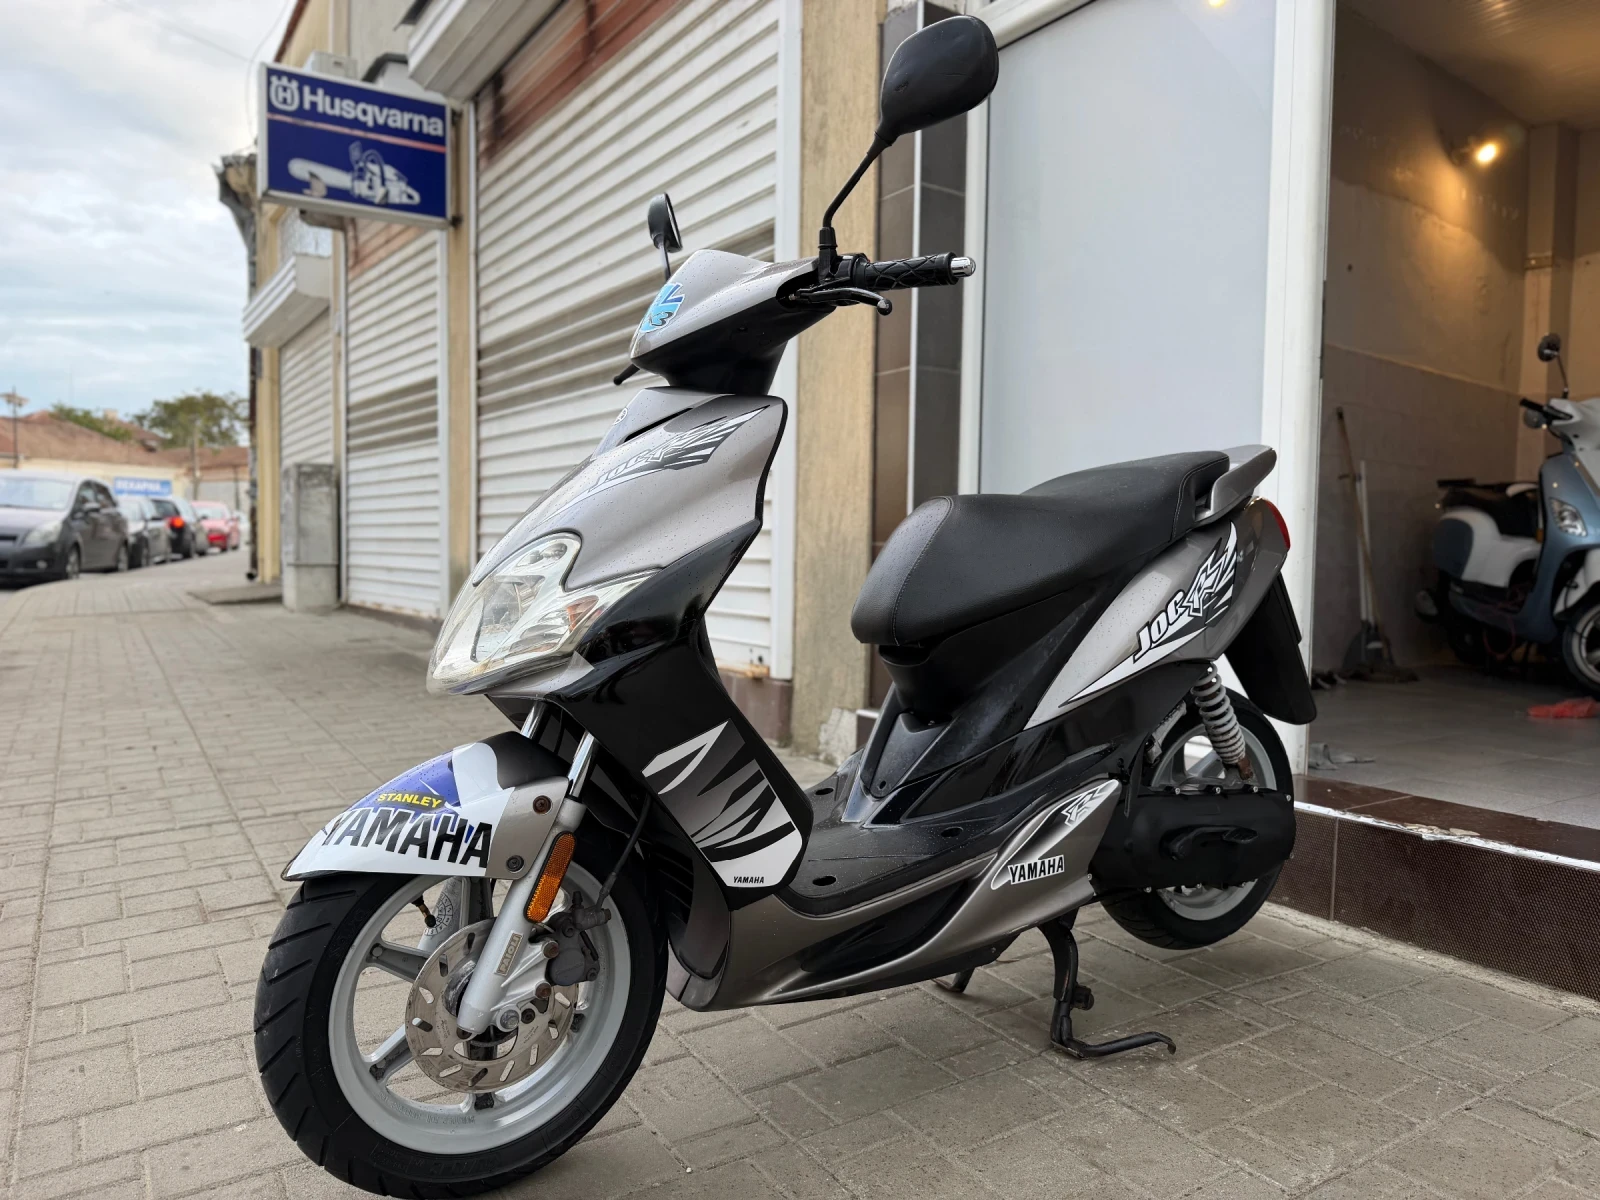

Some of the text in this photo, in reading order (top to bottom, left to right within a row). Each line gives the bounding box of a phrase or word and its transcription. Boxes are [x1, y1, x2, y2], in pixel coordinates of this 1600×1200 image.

[302, 85, 444, 136] Husqvarna
[377, 792, 443, 809] STANLEY
[321, 806, 494, 869] YAMAHA
[733, 876, 765, 884] YAMAHA
[1009, 855, 1064, 883] YAMAHA
